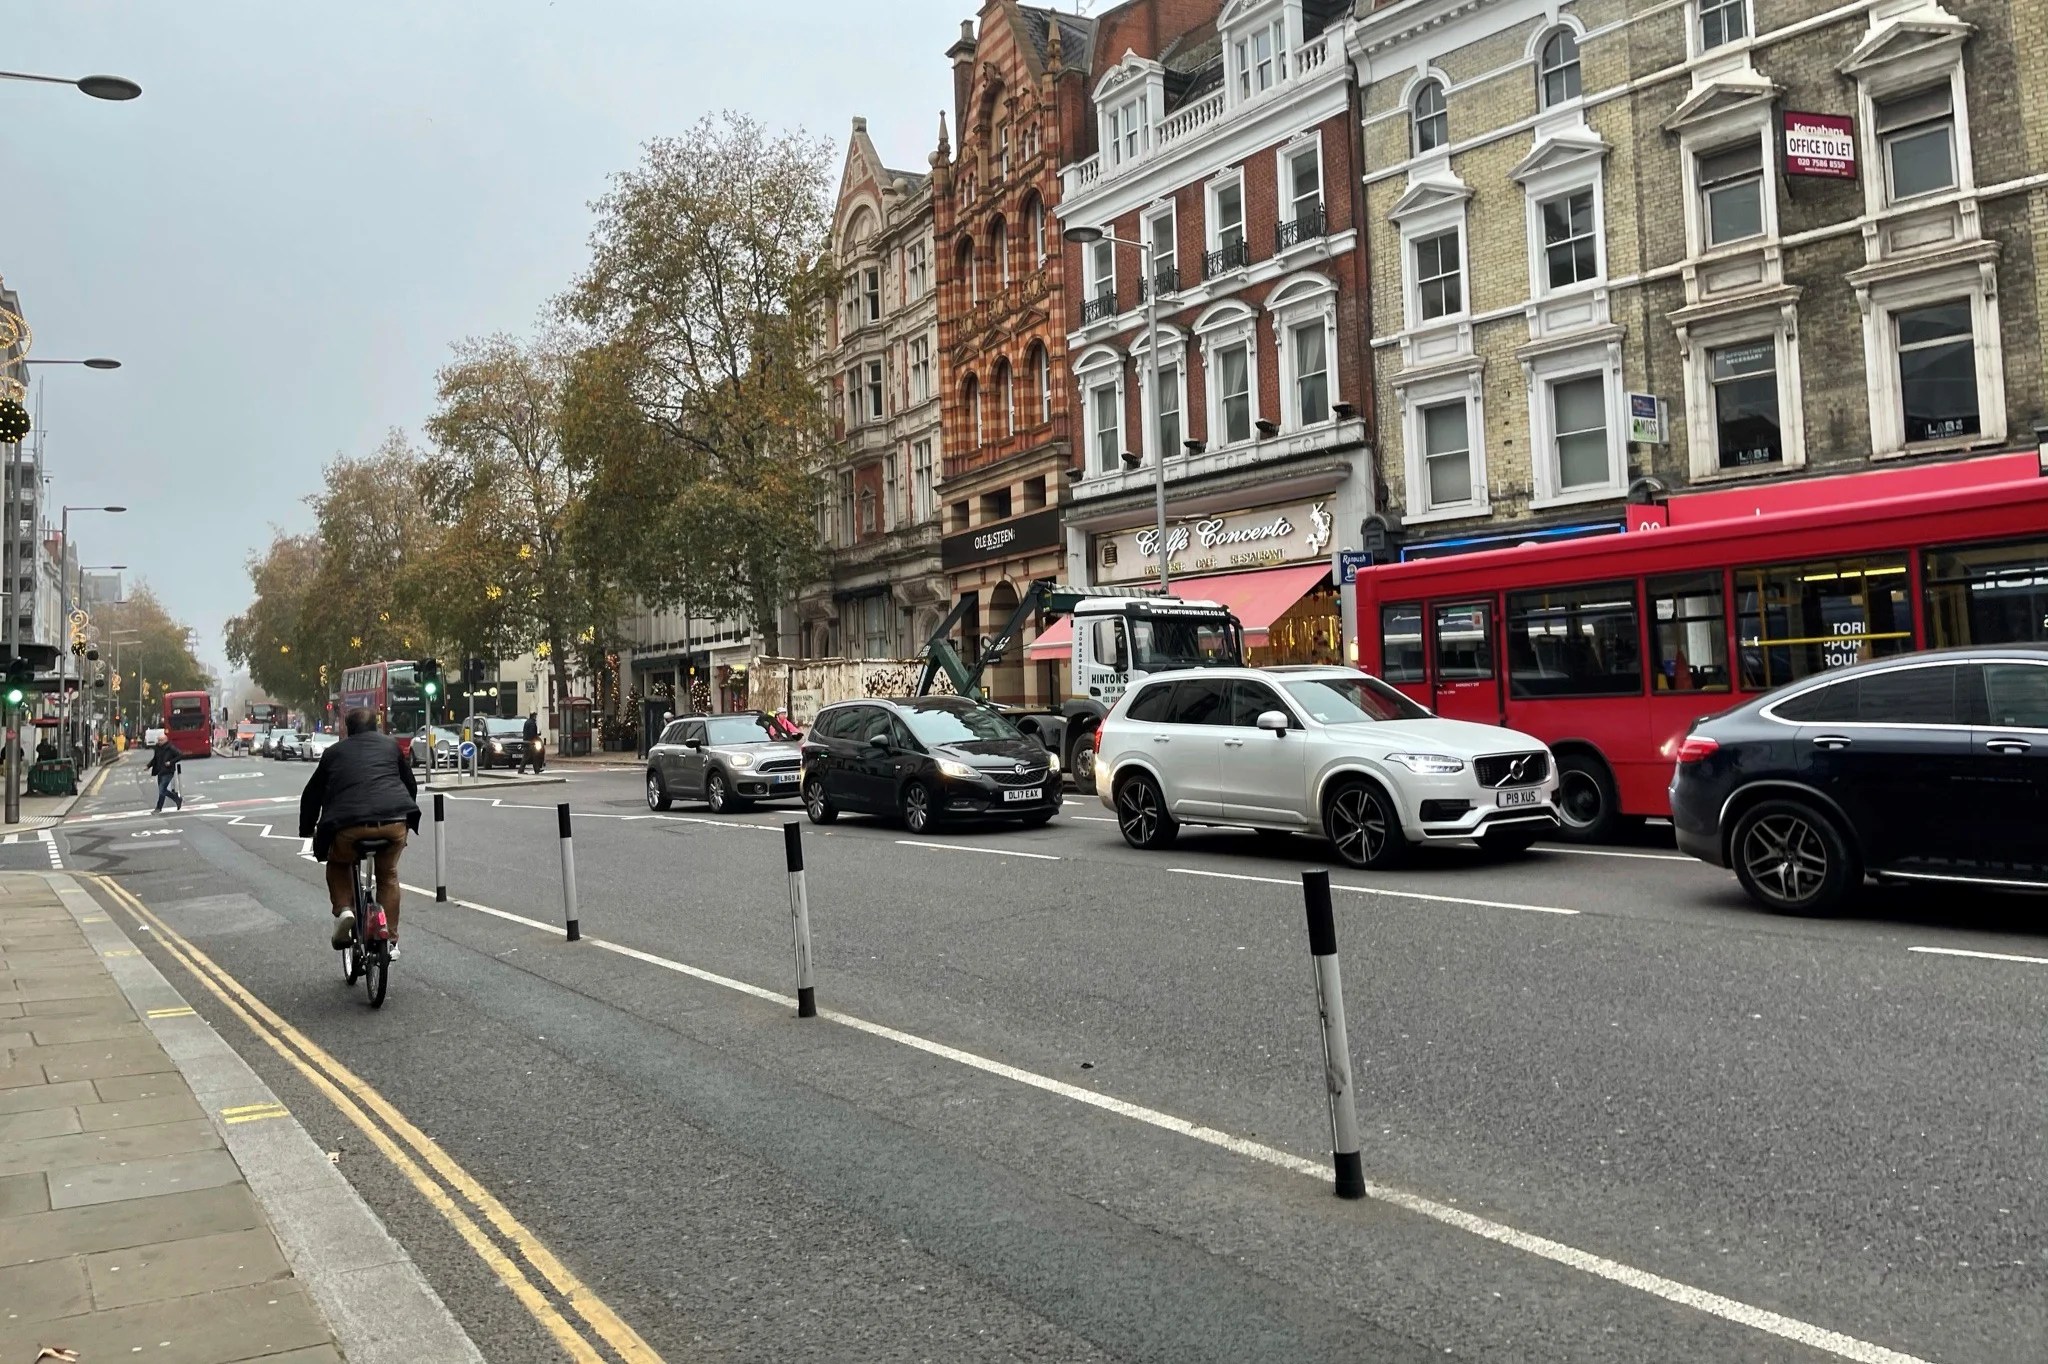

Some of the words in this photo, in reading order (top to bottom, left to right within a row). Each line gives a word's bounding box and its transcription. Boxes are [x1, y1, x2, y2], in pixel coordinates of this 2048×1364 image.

[1793, 122, 1845, 137] Kernahans
[1789, 138, 1821, 154] OFFICE
[1822, 140, 1834, 155] TO
[1836, 142, 1850, 157] LET
[1797, 157, 1811, 166] 020
[1726, 353, 1763, 365] NECESSARY
[1195, 516, 1294, 549] Concerto
[1091, 673, 1129, 685] HINTON'S
[1104, 686, 1116, 694] SKIP
[1008, 790, 1024, 800] DL17
[1025, 789, 1039, 798] EAX
[1506, 792, 1519, 804] P19
[1521, 791, 1536, 803] XUS
